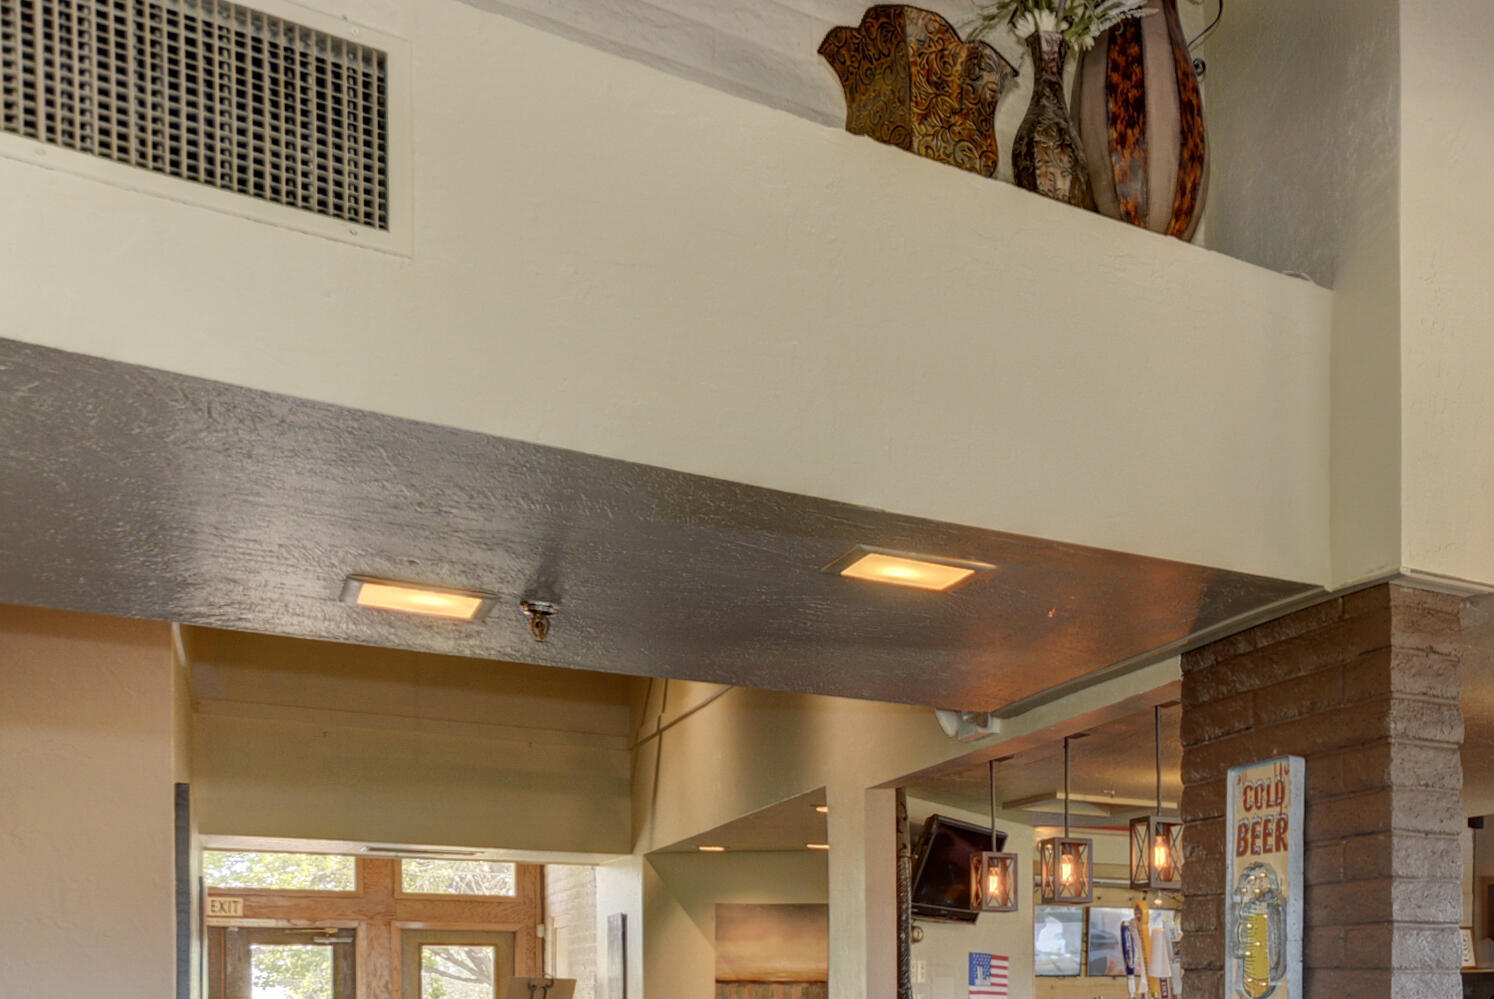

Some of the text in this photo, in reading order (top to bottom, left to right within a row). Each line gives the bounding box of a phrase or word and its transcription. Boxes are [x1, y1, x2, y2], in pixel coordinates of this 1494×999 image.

[1242, 775, 1286, 813] COLD
[1236, 813, 1289, 858] BEER
[210, 899, 240, 914] EXIT
